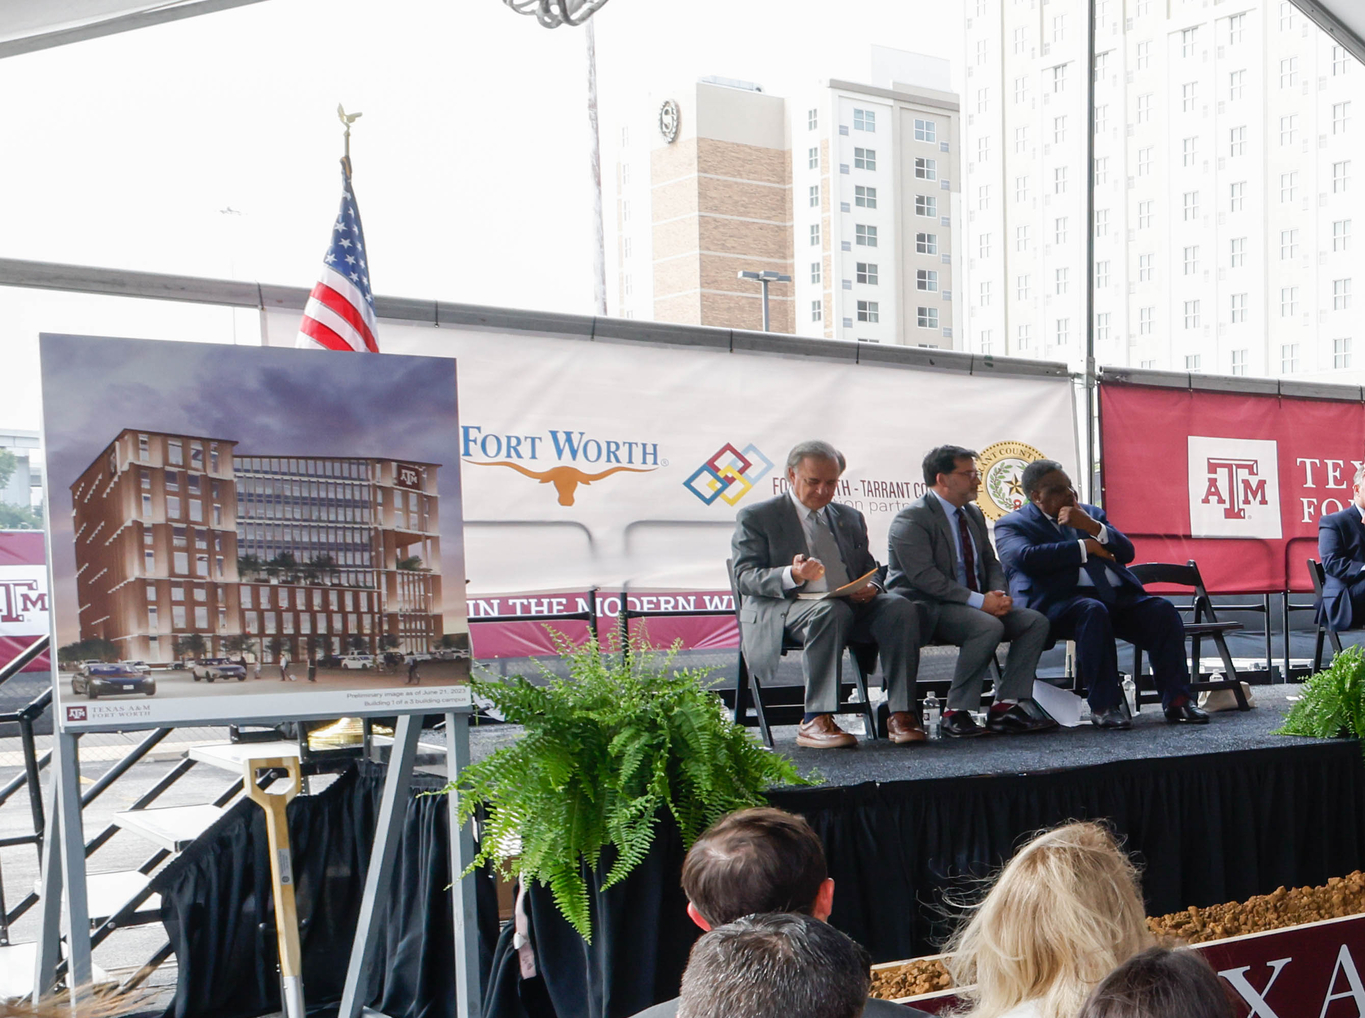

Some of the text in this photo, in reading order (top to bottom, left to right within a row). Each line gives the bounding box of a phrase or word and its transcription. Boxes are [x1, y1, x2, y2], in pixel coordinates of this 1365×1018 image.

[461, 425, 659, 466] FORT WORTH
[860, 479, 911, 499] TARRANT
[466, 599, 500, 618] IN
[508, 598, 567, 616] THE
[575, 596, 696, 617] MODERN
[92, 705, 125, 713] TEXAS
